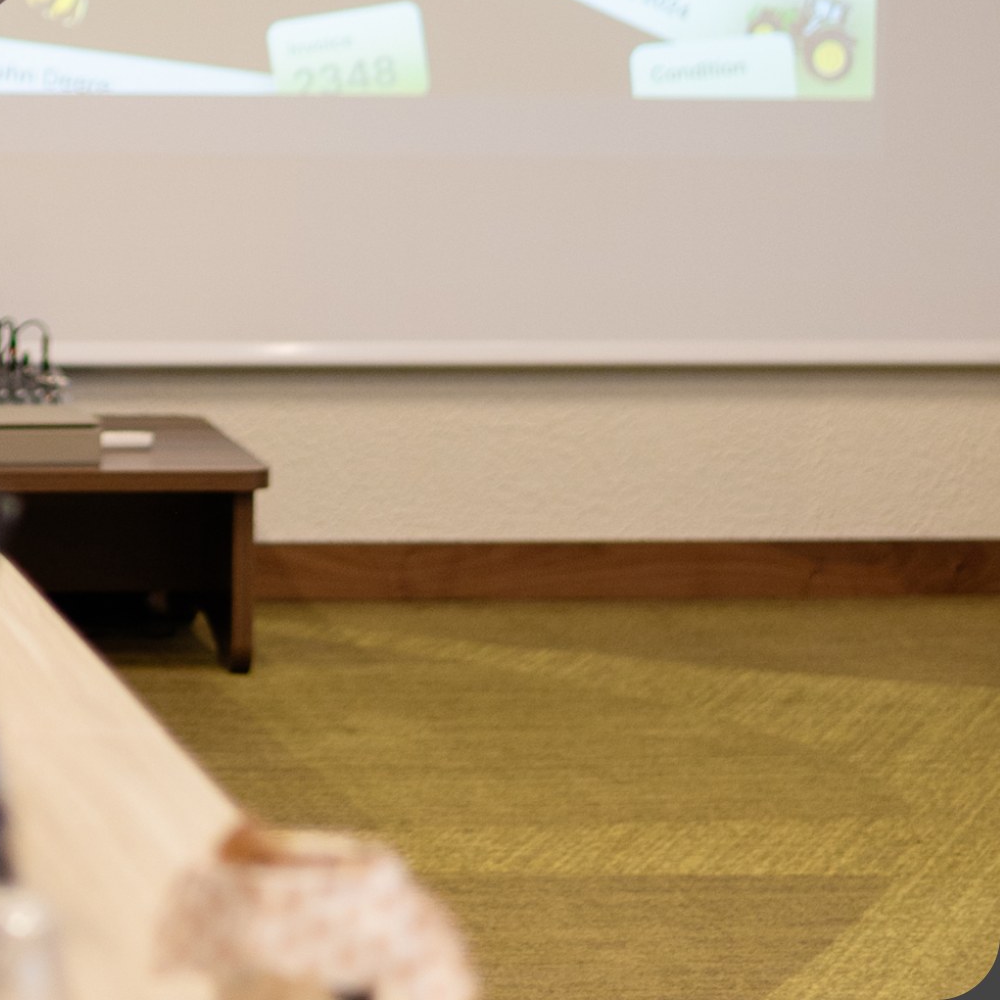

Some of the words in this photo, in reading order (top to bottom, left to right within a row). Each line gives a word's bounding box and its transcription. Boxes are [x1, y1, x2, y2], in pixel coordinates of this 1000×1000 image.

[42, 66, 111, 94] Deere
[293, 54, 397, 96] 2348
[650, 60, 748, 84] Condition
